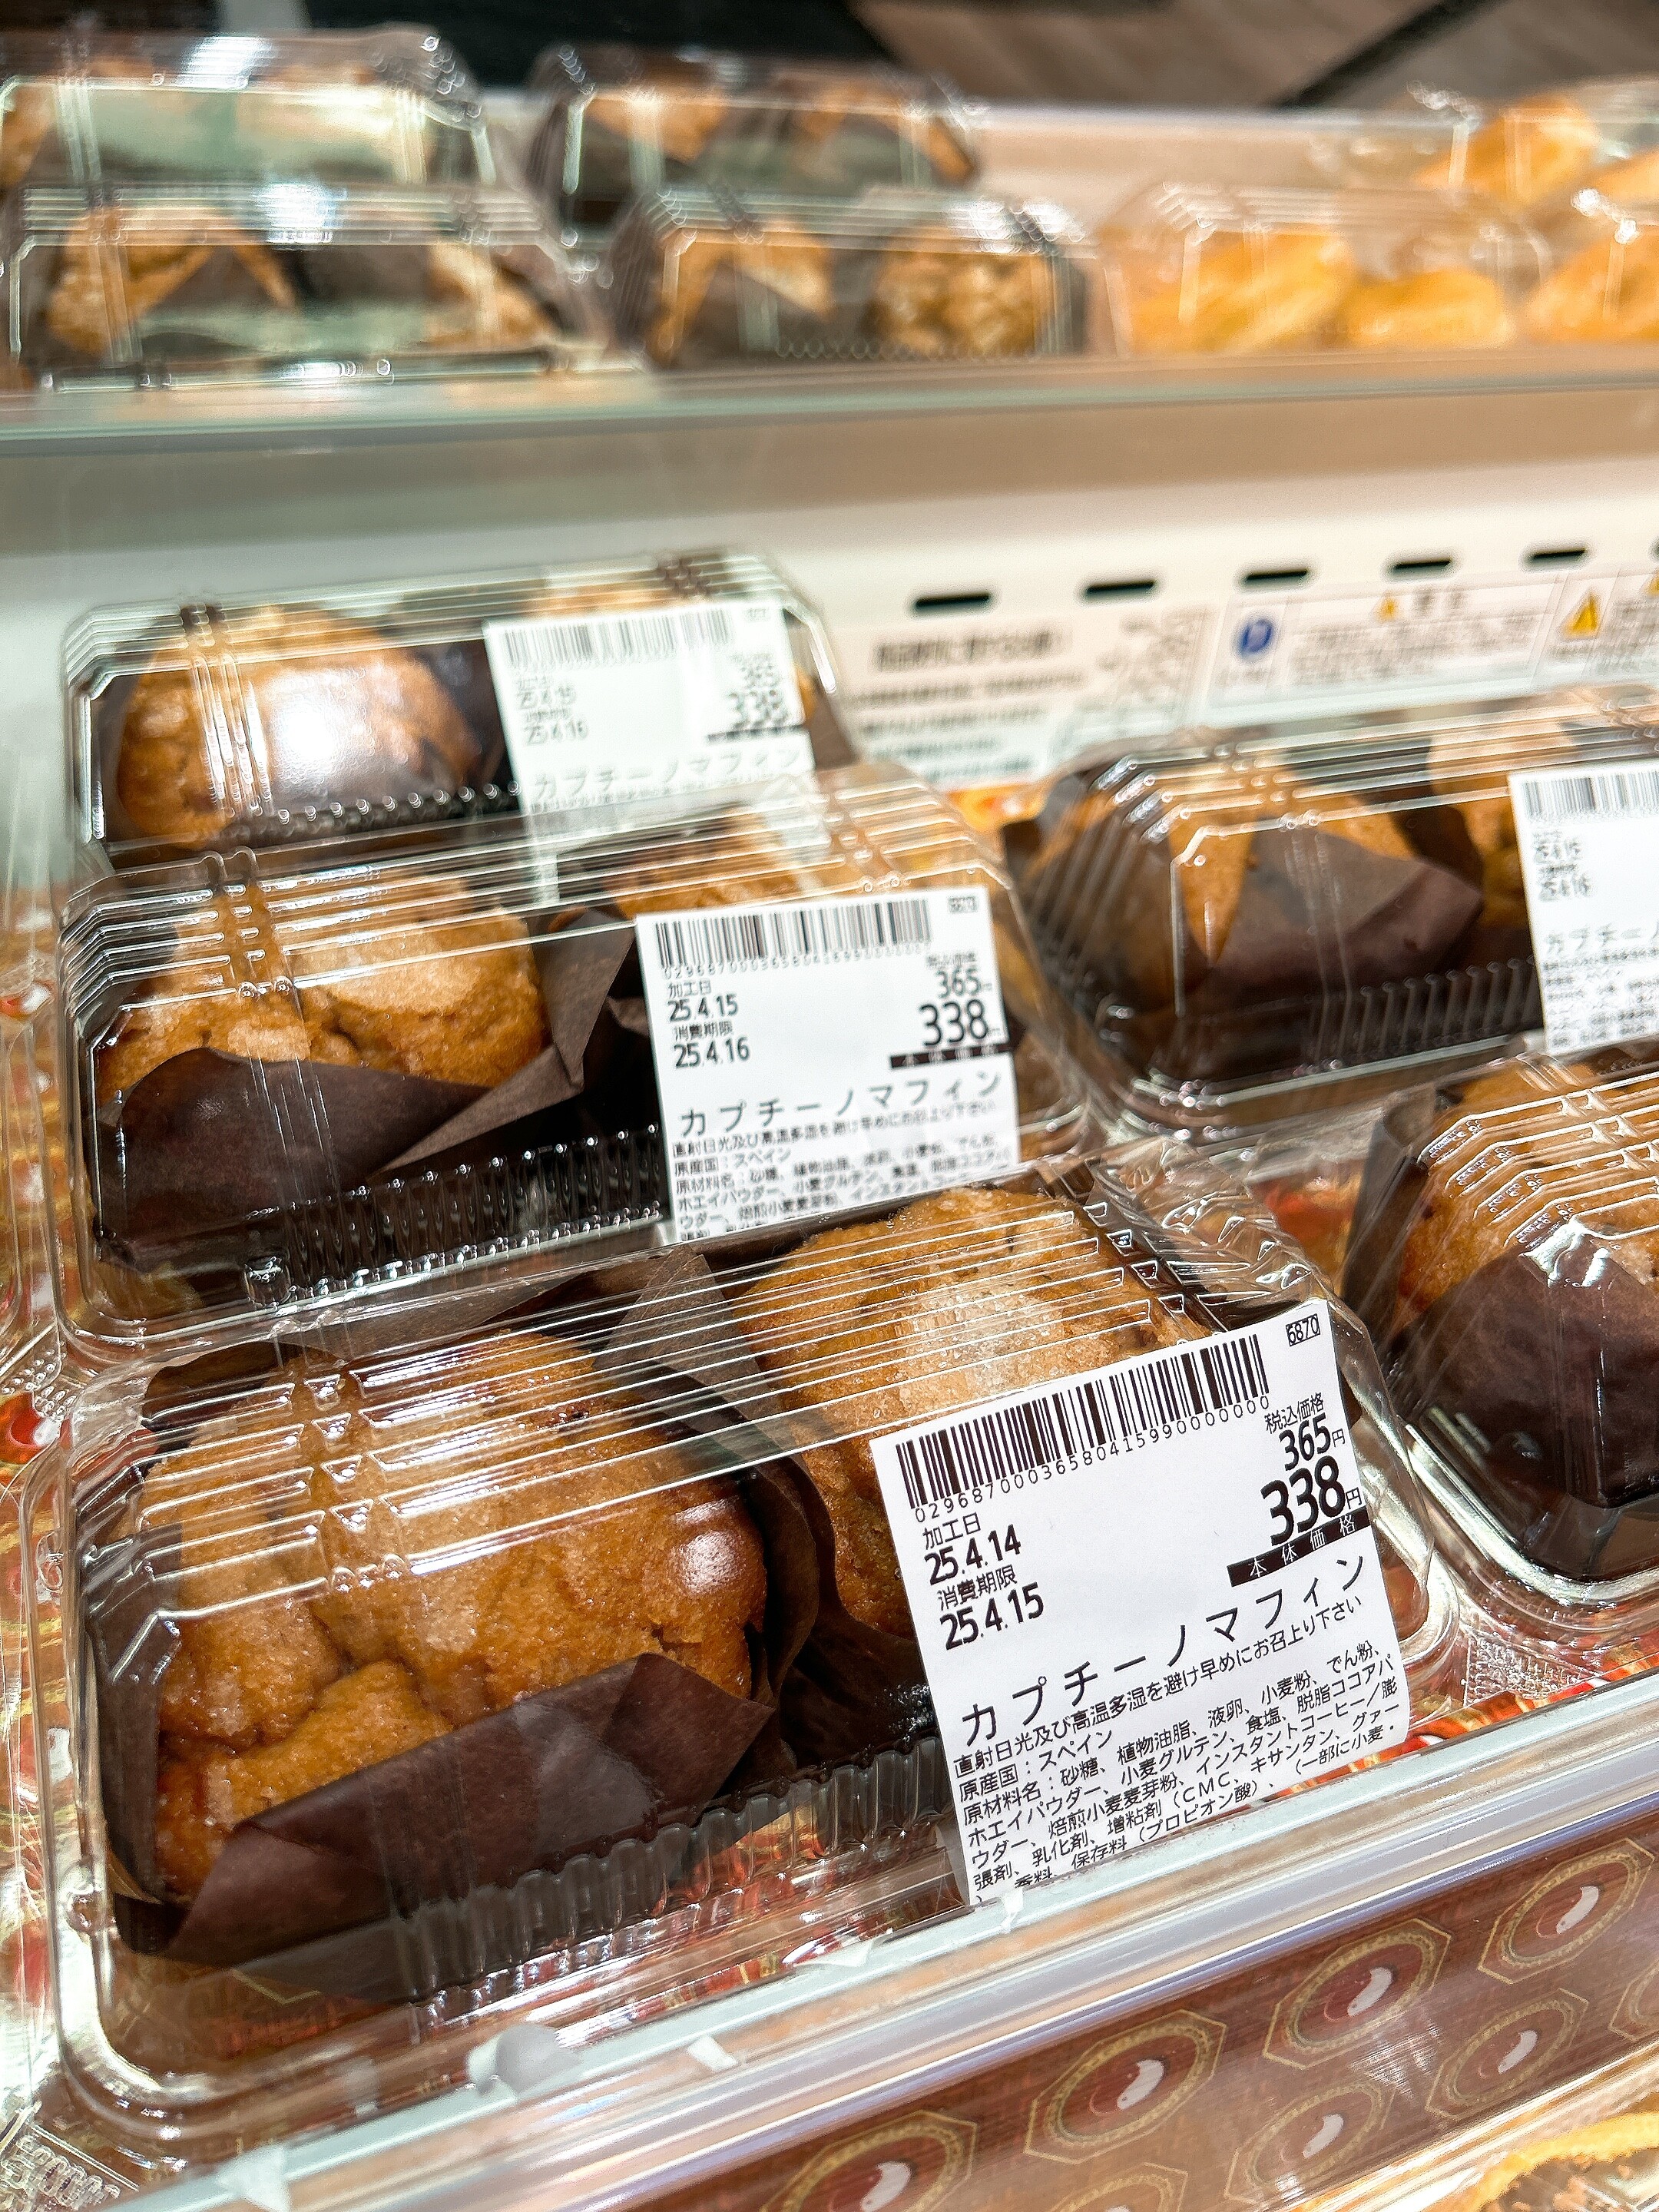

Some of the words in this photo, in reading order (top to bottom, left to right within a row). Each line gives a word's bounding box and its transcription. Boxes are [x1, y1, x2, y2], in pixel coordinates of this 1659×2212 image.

[667, 979, 712, 998] 加工日
[667, 993, 739, 1022] 25.4.15
[673, 1035, 750, 1069] 25.4.16
[680, 1070, 1003, 1137] カプチーノマフィン
[1286, 1314, 1320, 1346] 6870
[1265, 1392, 1325, 1435] 税込価格
[922, 1512, 982, 1551] 加工日
[924, 1524, 1022, 1586] 25.4.14
[937, 1564, 1018, 1611] 消費期限
[939, 1581, 1045, 1651] 25.4.15
[962, 1555, 1363, 1747] カプチーノマフィン
[952, 1595, 1363, 1779] 直射日光及び高温多湿を避け早めにお召上り下さい
[959, 1730, 1113, 1803] 原産国：スペイン
